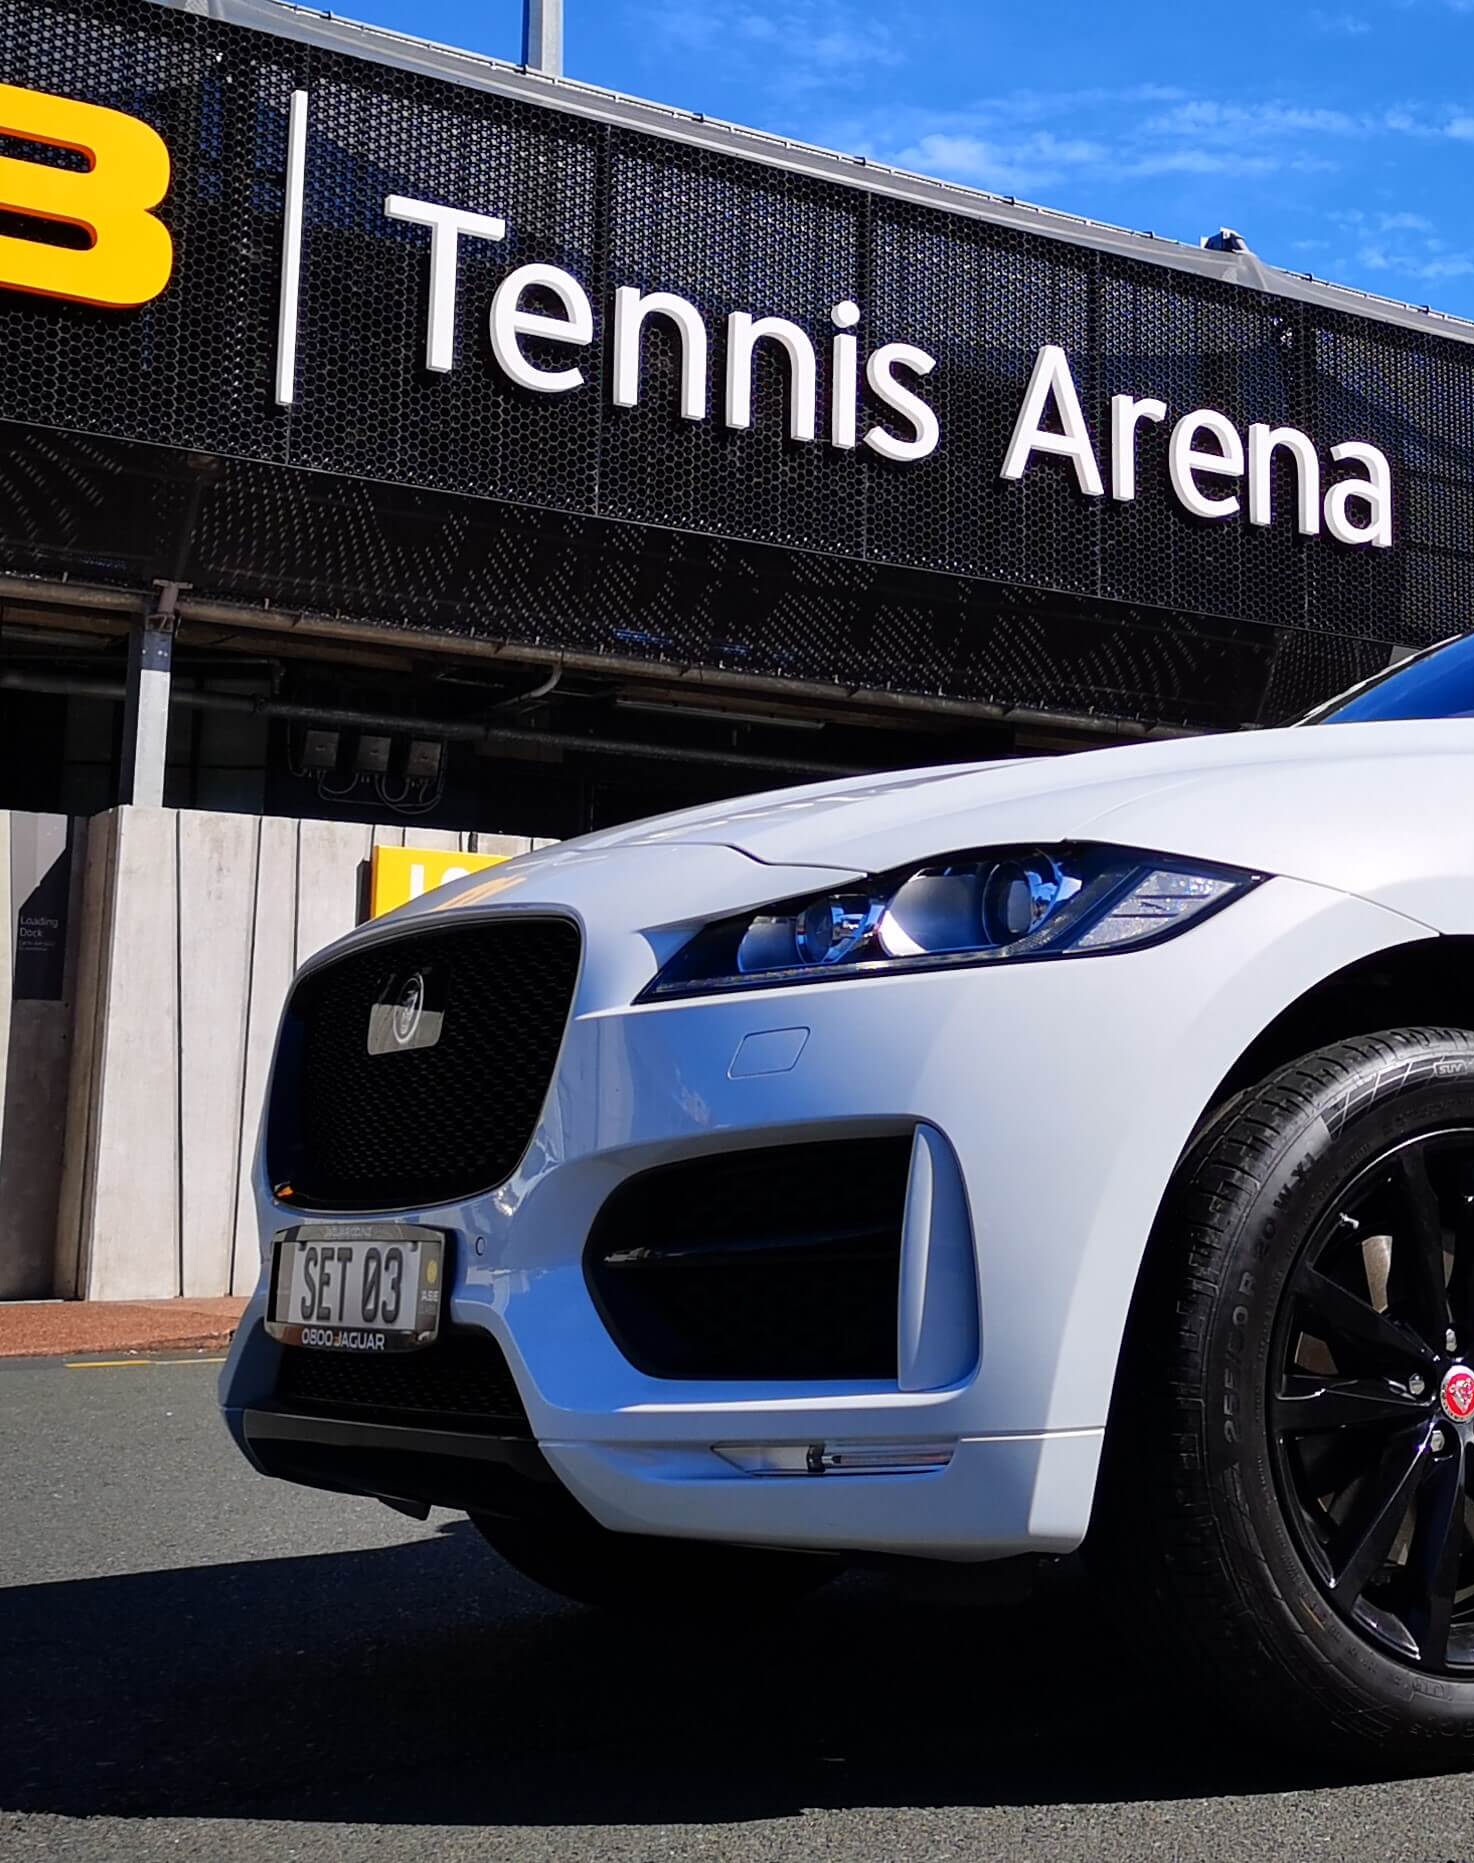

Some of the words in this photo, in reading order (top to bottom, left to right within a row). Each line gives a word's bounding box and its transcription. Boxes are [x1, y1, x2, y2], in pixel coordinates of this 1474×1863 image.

[0, 84, 173, 308] B
[384, 194, 940, 463] Tennis
[1000, 345, 1394, 549] Arena
[20, 915, 59, 929] Loading
[19, 927, 43, 938] Dock
[1438, 1062, 1465, 1075] SUV
[301, 1246, 353, 1322] SET
[361, 1247, 403, 1325] 03
